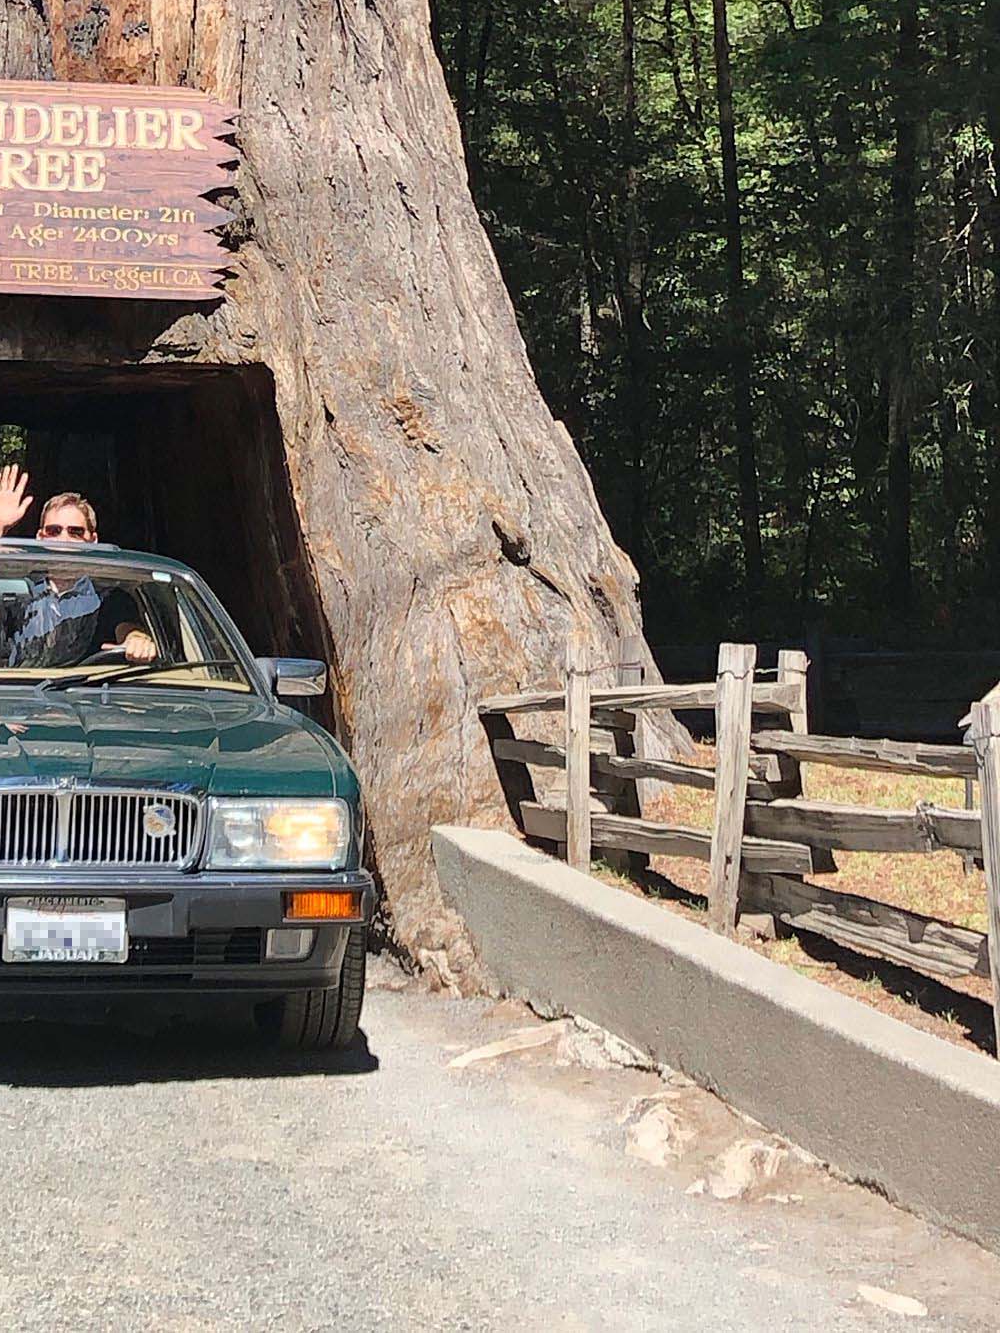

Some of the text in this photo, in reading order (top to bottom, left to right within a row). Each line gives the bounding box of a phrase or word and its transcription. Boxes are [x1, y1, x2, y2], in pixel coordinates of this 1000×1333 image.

[33, 201, 150, 222] Diameter:
[158, 206, 196, 225] 21ft
[8, 222, 64, 249] Age:
[72, 225, 180, 248] 2400yrs
[172, 269, 203, 286] CA
[33, 896, 99, 906] SACRAMENTO
[32, 947, 99, 961] JAGUAR
